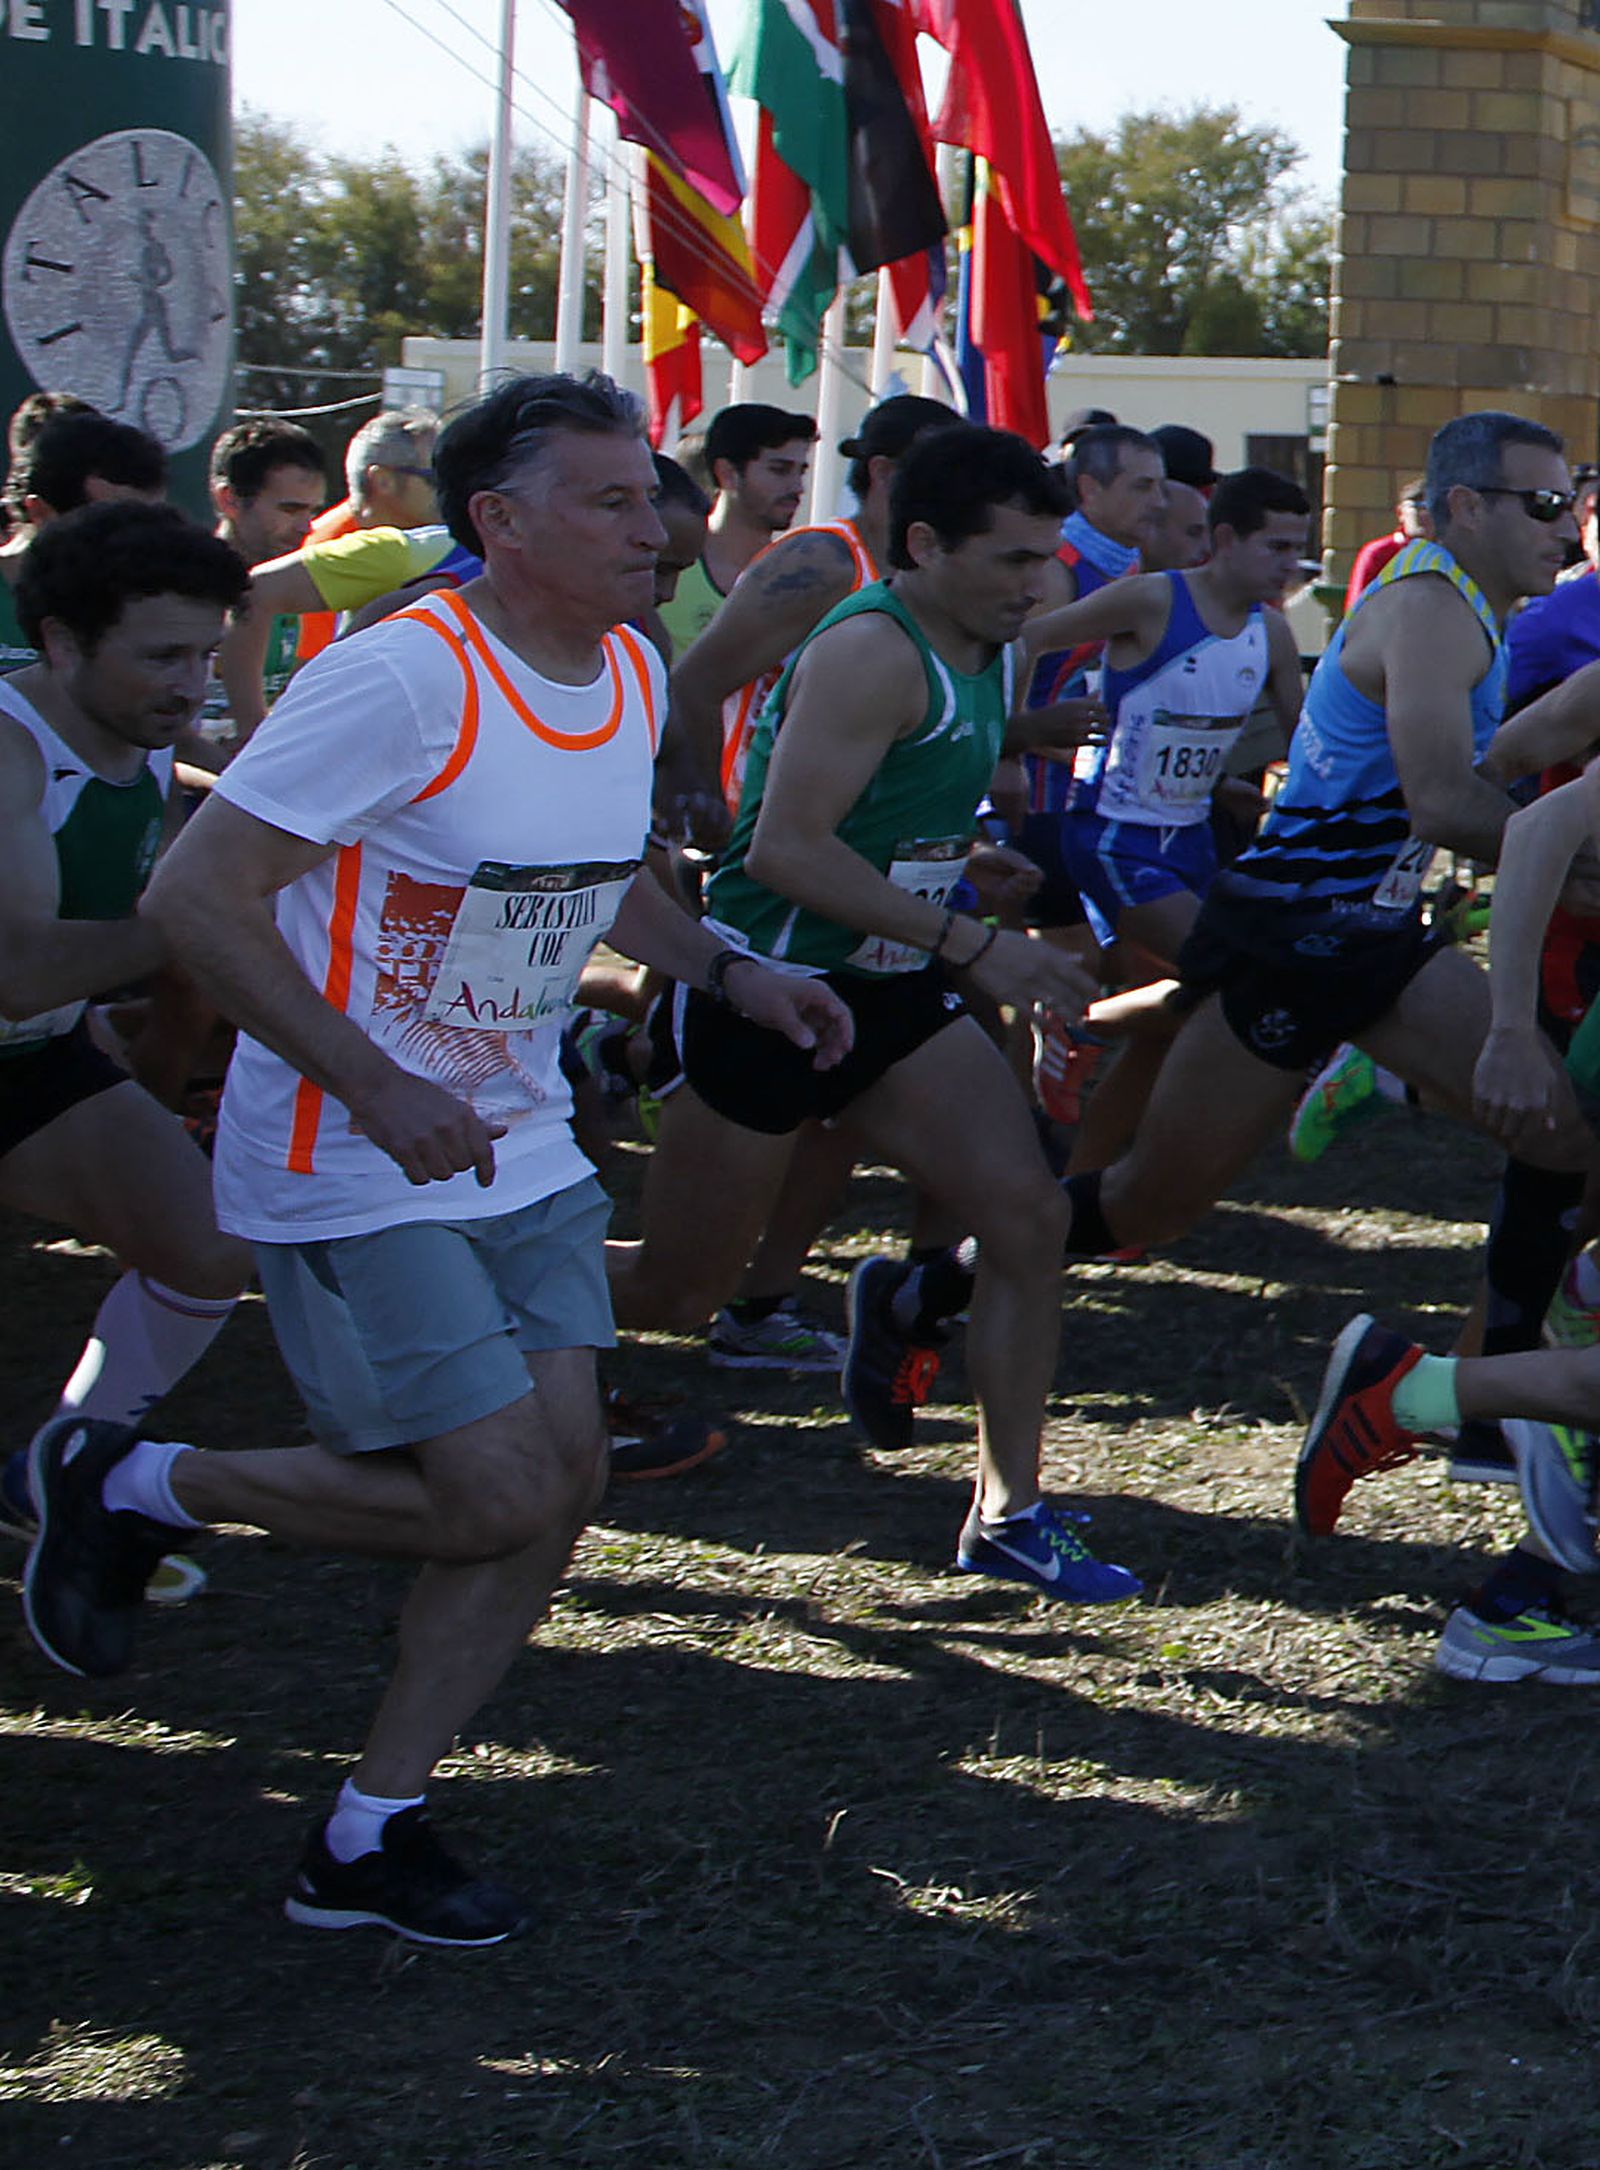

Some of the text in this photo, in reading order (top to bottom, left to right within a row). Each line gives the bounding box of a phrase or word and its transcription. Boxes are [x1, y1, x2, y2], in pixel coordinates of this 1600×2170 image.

[0, 0, 52, 41] E
[1156, 745, 1220, 779] 1830
[528, 931, 571, 967] COE
